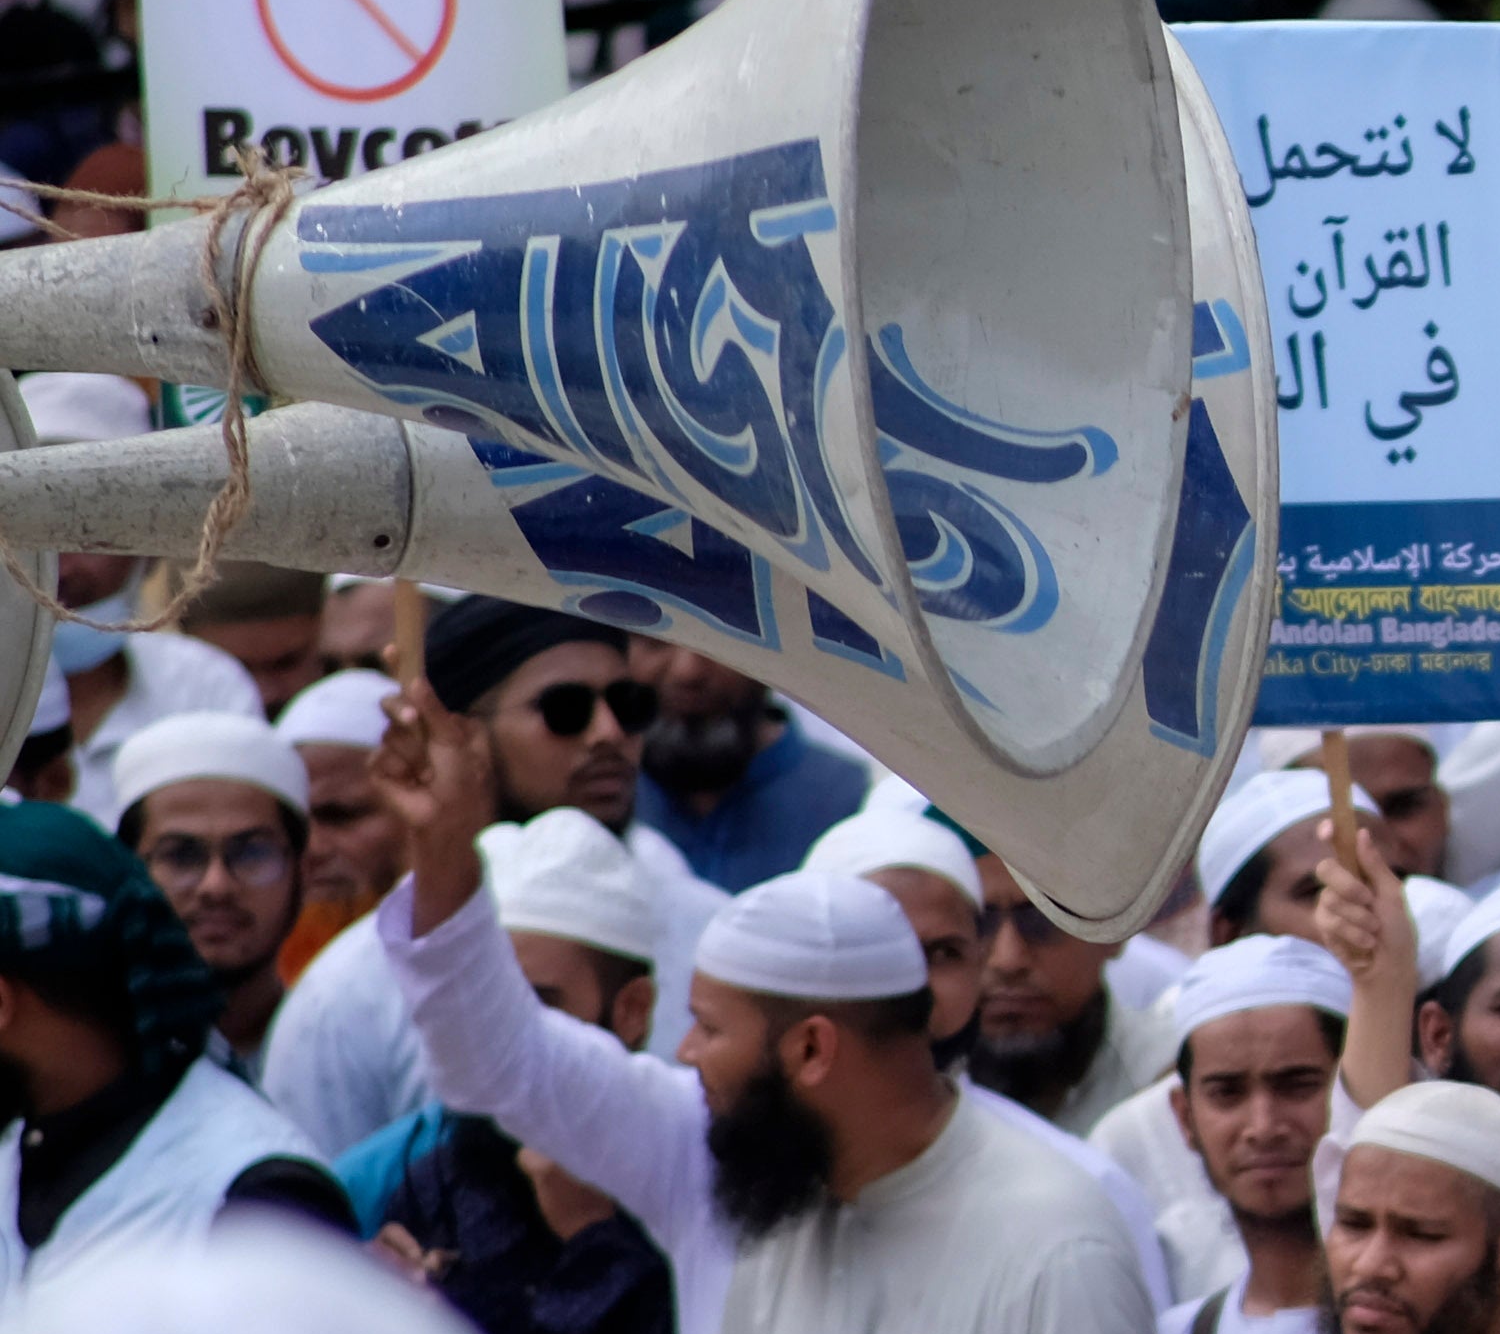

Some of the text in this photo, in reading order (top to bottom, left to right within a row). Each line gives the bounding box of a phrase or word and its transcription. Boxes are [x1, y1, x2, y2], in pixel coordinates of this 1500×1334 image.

[203, 108, 516, 188] Boyco
[1246, 105, 1476, 208] لا نتحمل
[1287, 215, 1452, 319] القرآن
[1363, 320, 1461, 466] في
[1269, 616, 1374, 645] Andolan
[1288, 585, 1412, 620] আন্দোলন
